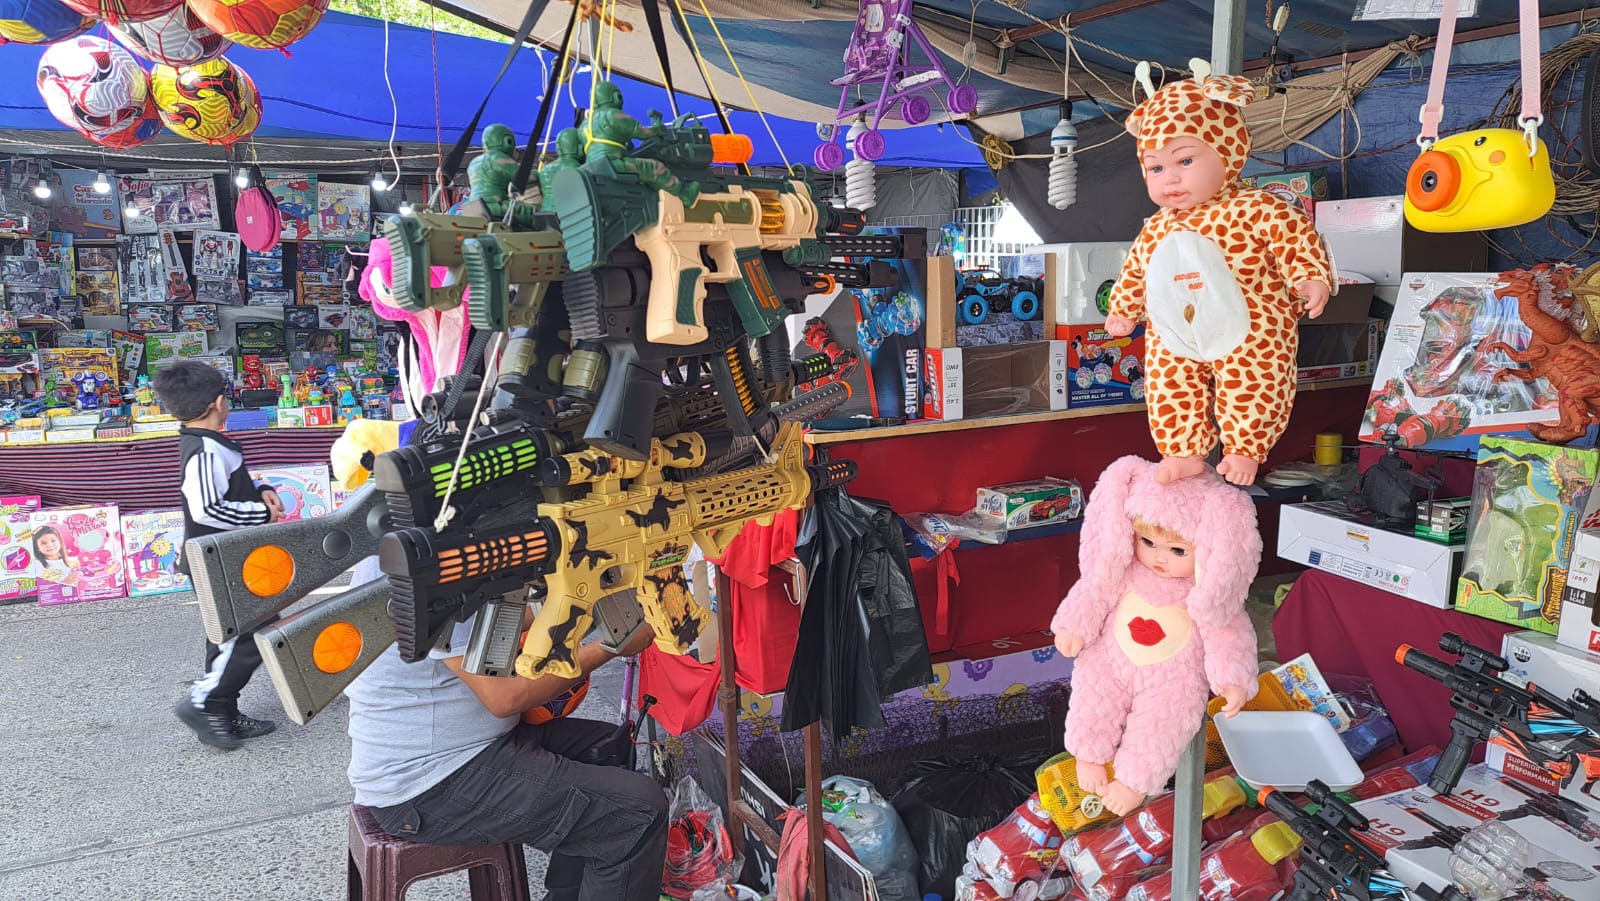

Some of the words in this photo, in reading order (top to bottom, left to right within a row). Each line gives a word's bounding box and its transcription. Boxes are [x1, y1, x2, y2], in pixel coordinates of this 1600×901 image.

[905, 348, 918, 373] CAR
[905, 377, 917, 414] STUNT
[98, 427, 132, 439] MUSIC
[1569, 588, 1586, 600] 1:14
[1507, 755, 1541, 773] SUPERIOR
[1506, 763, 1557, 787] PERFORMANCE
[1460, 789, 1501, 807] H9
[1368, 818, 1406, 836] H9
